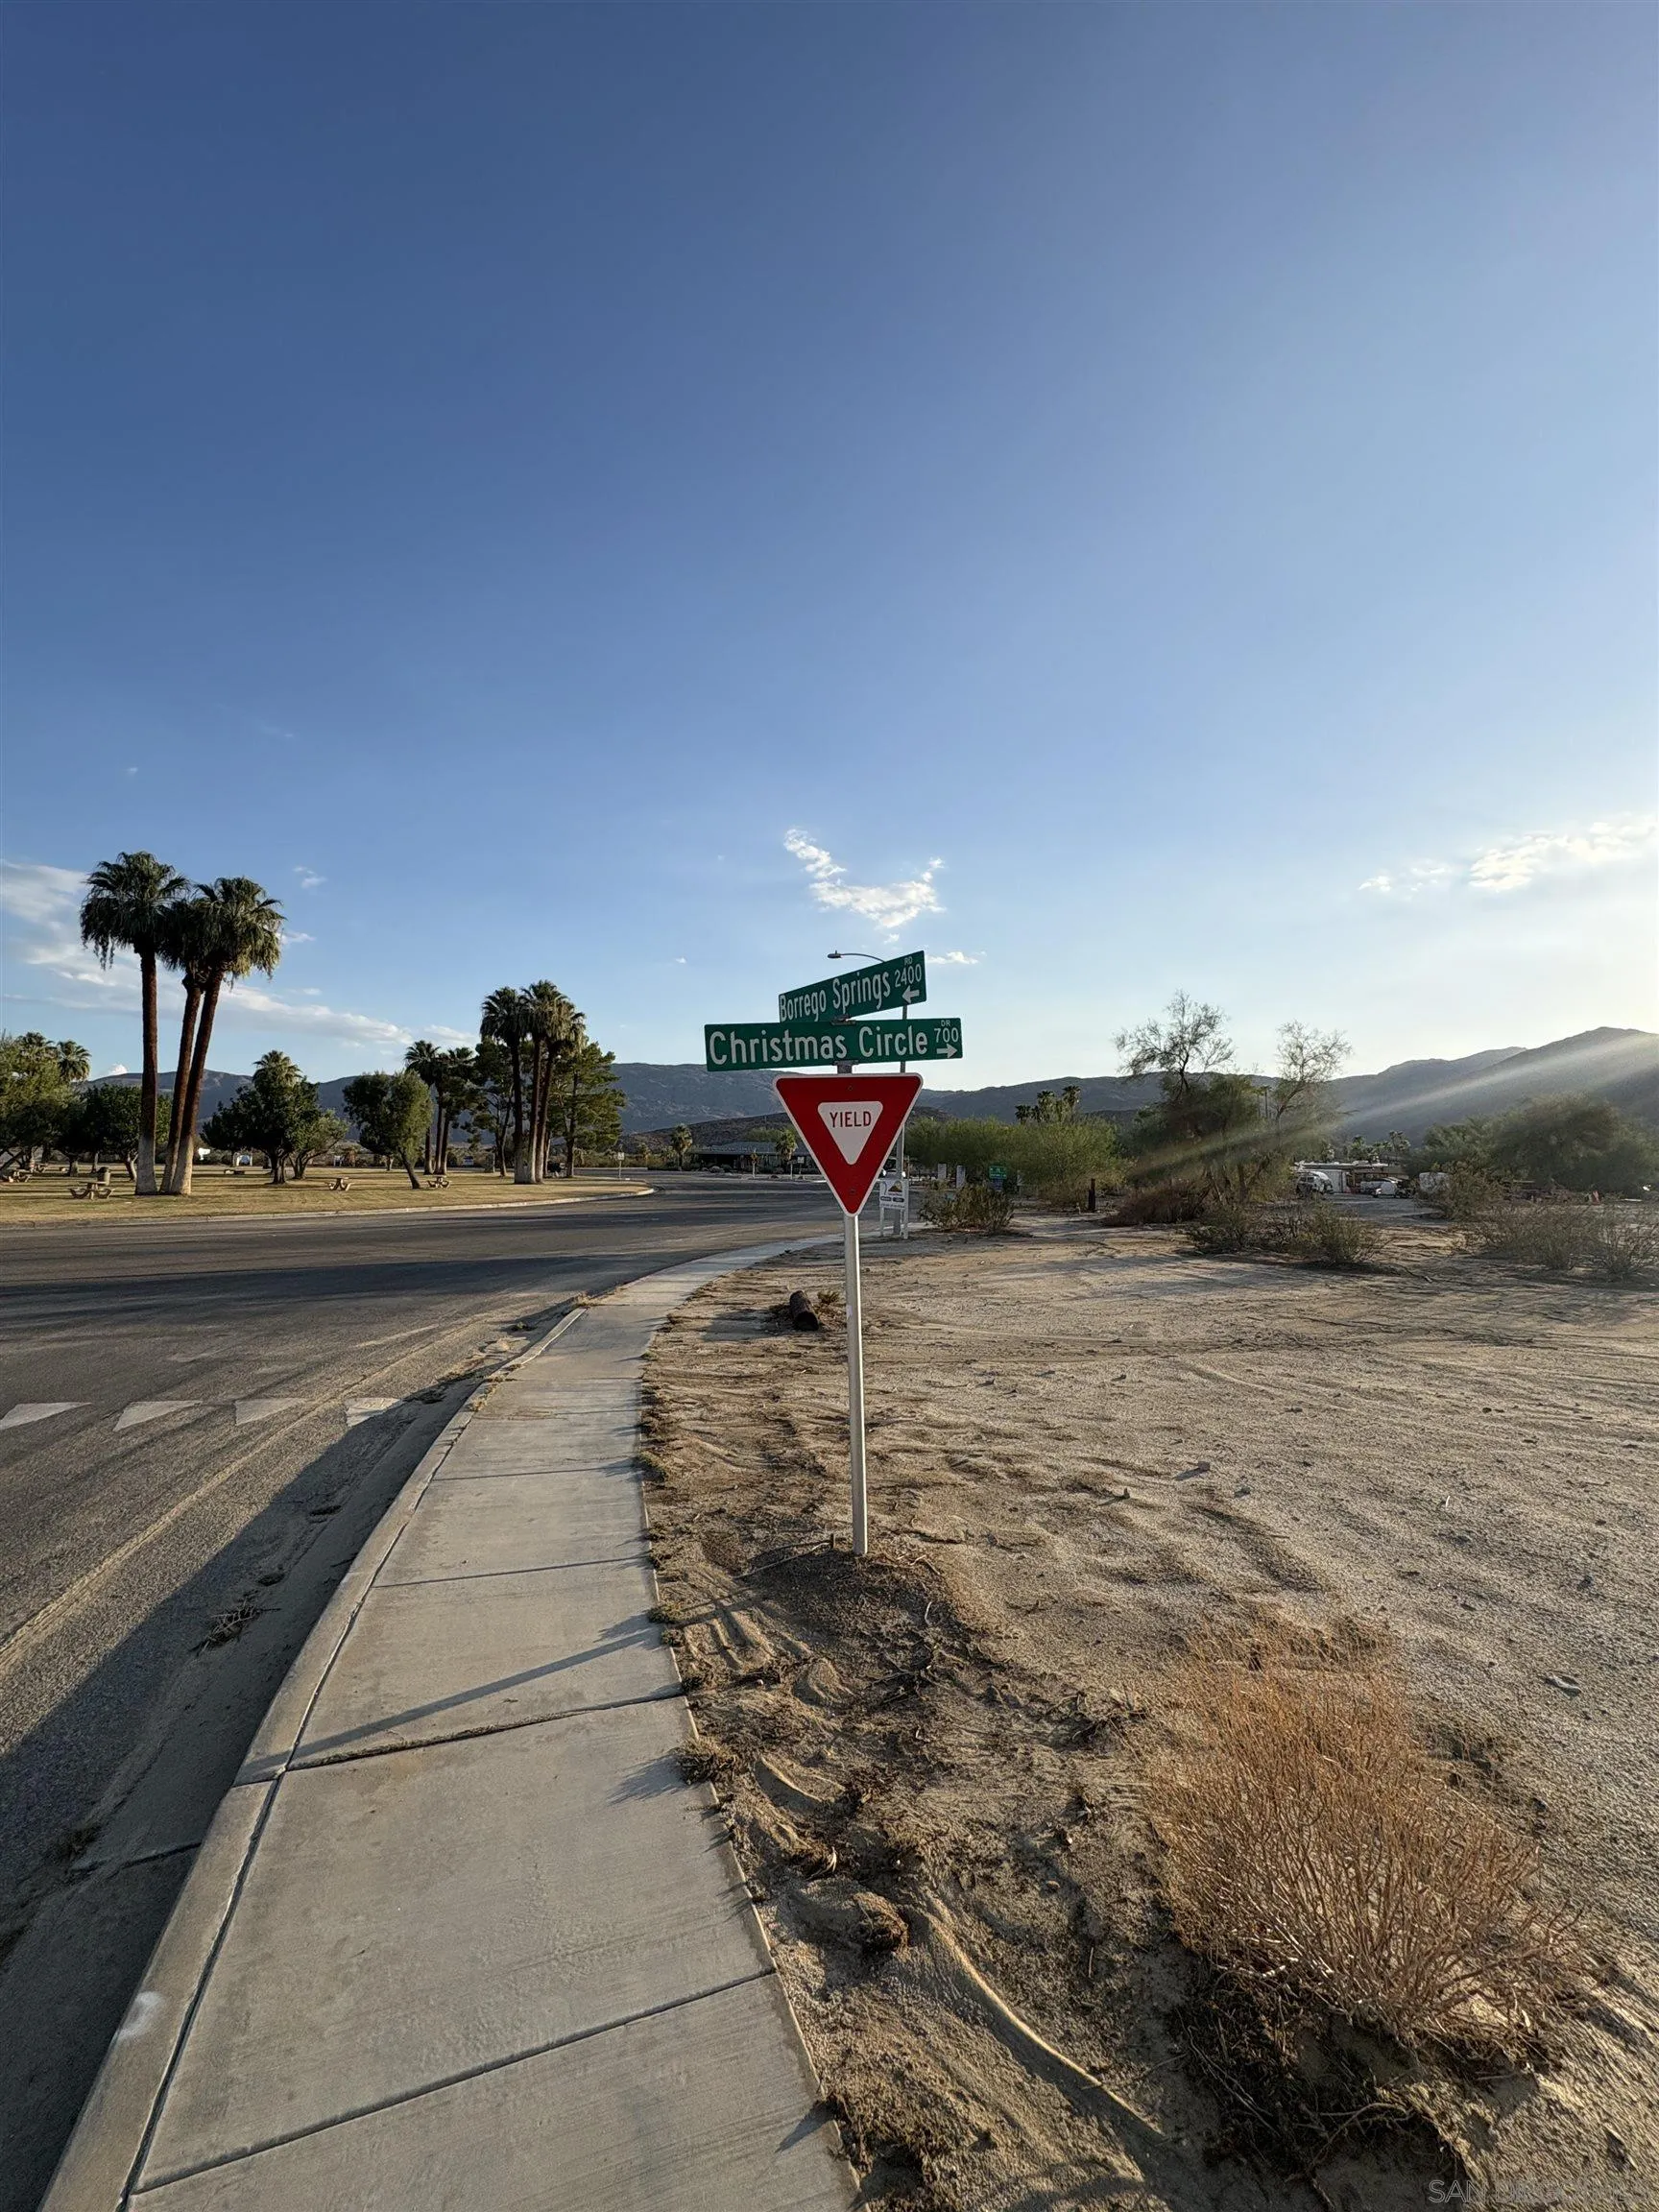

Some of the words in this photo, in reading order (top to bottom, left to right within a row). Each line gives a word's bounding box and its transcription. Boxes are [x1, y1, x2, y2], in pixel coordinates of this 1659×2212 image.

[904, 956, 913, 965] RD
[779, 991, 827, 1022] Borrego
[832, 972, 891, 1011] Springs
[894, 964, 922, 987] 2400
[709, 1029, 848, 1065] Christmas
[859, 1024, 928, 1058] Circle
[934, 1027, 959, 1044] 700
[830, 1111, 872, 1128] YIELD
